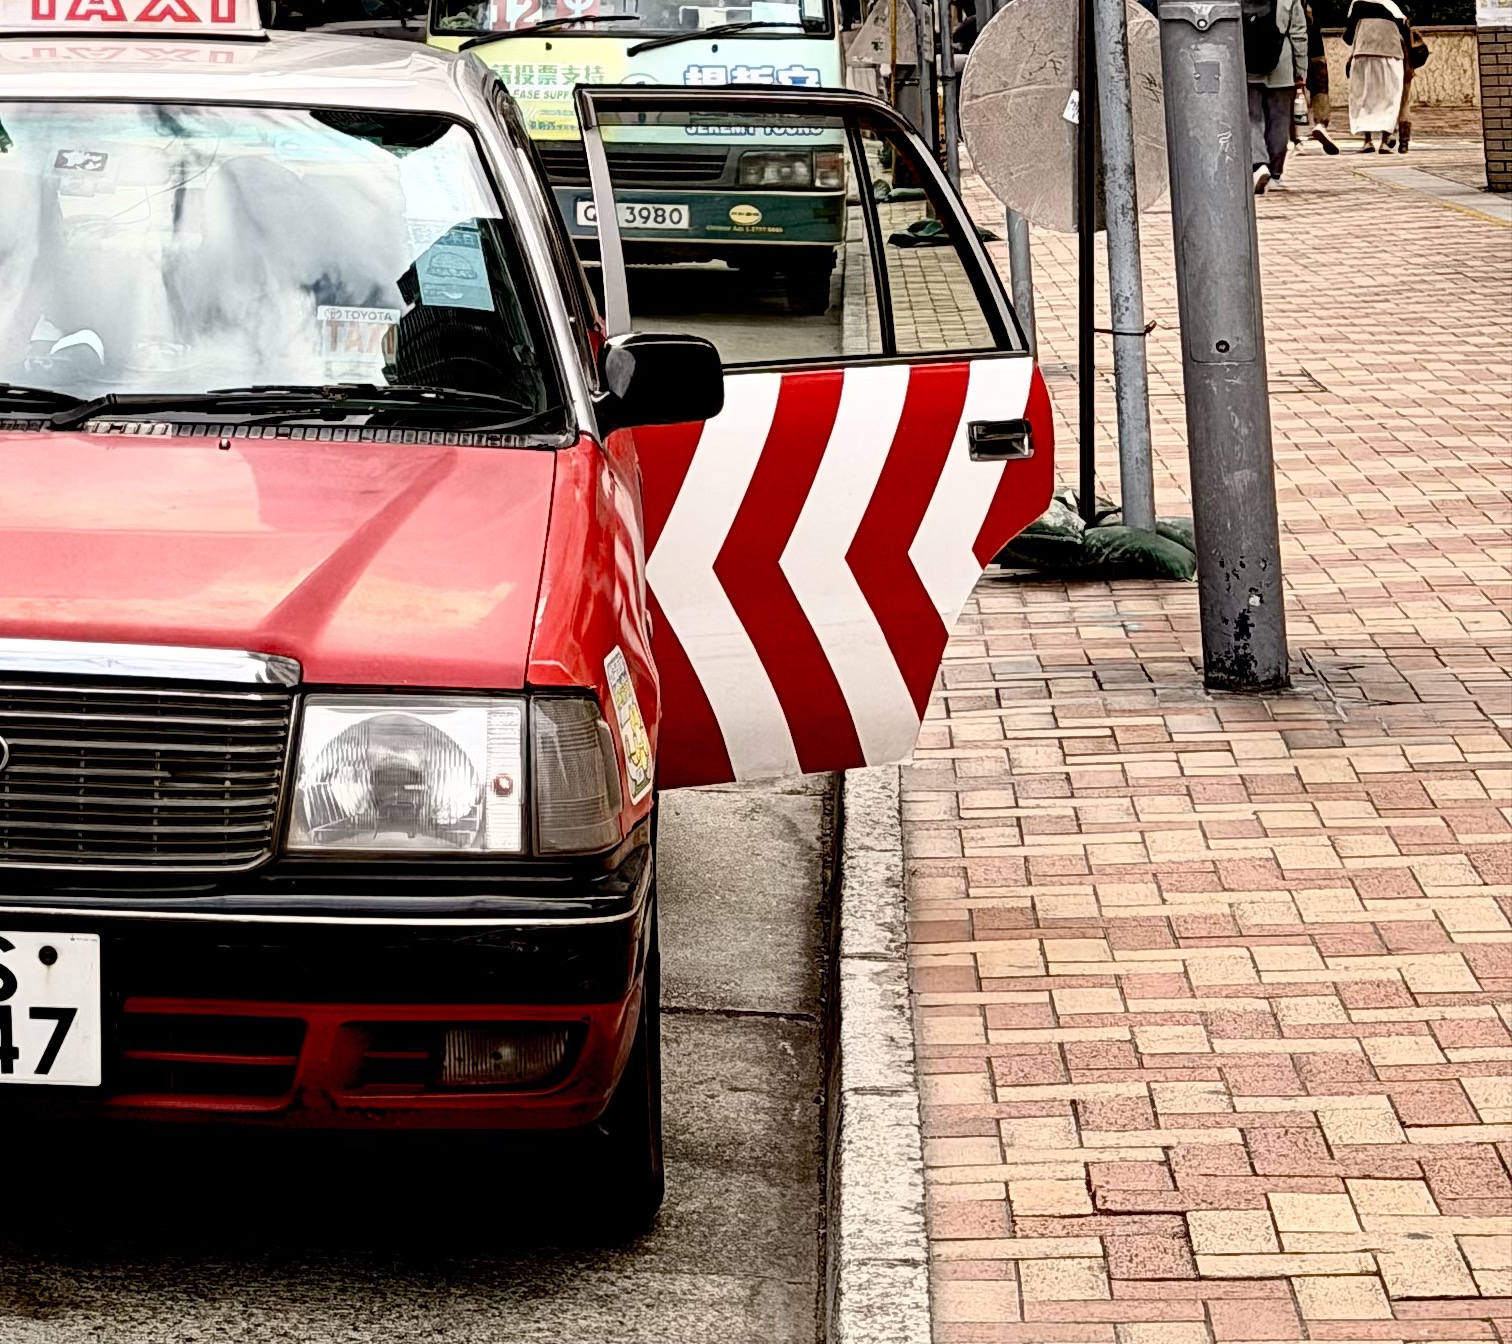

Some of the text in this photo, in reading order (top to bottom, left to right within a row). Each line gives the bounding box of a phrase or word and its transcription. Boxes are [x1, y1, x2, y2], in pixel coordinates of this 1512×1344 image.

[513, 89, 541, 99] EASE
[624, 206, 683, 225] 3980
[344, 310, 393, 322] TOYOTA
